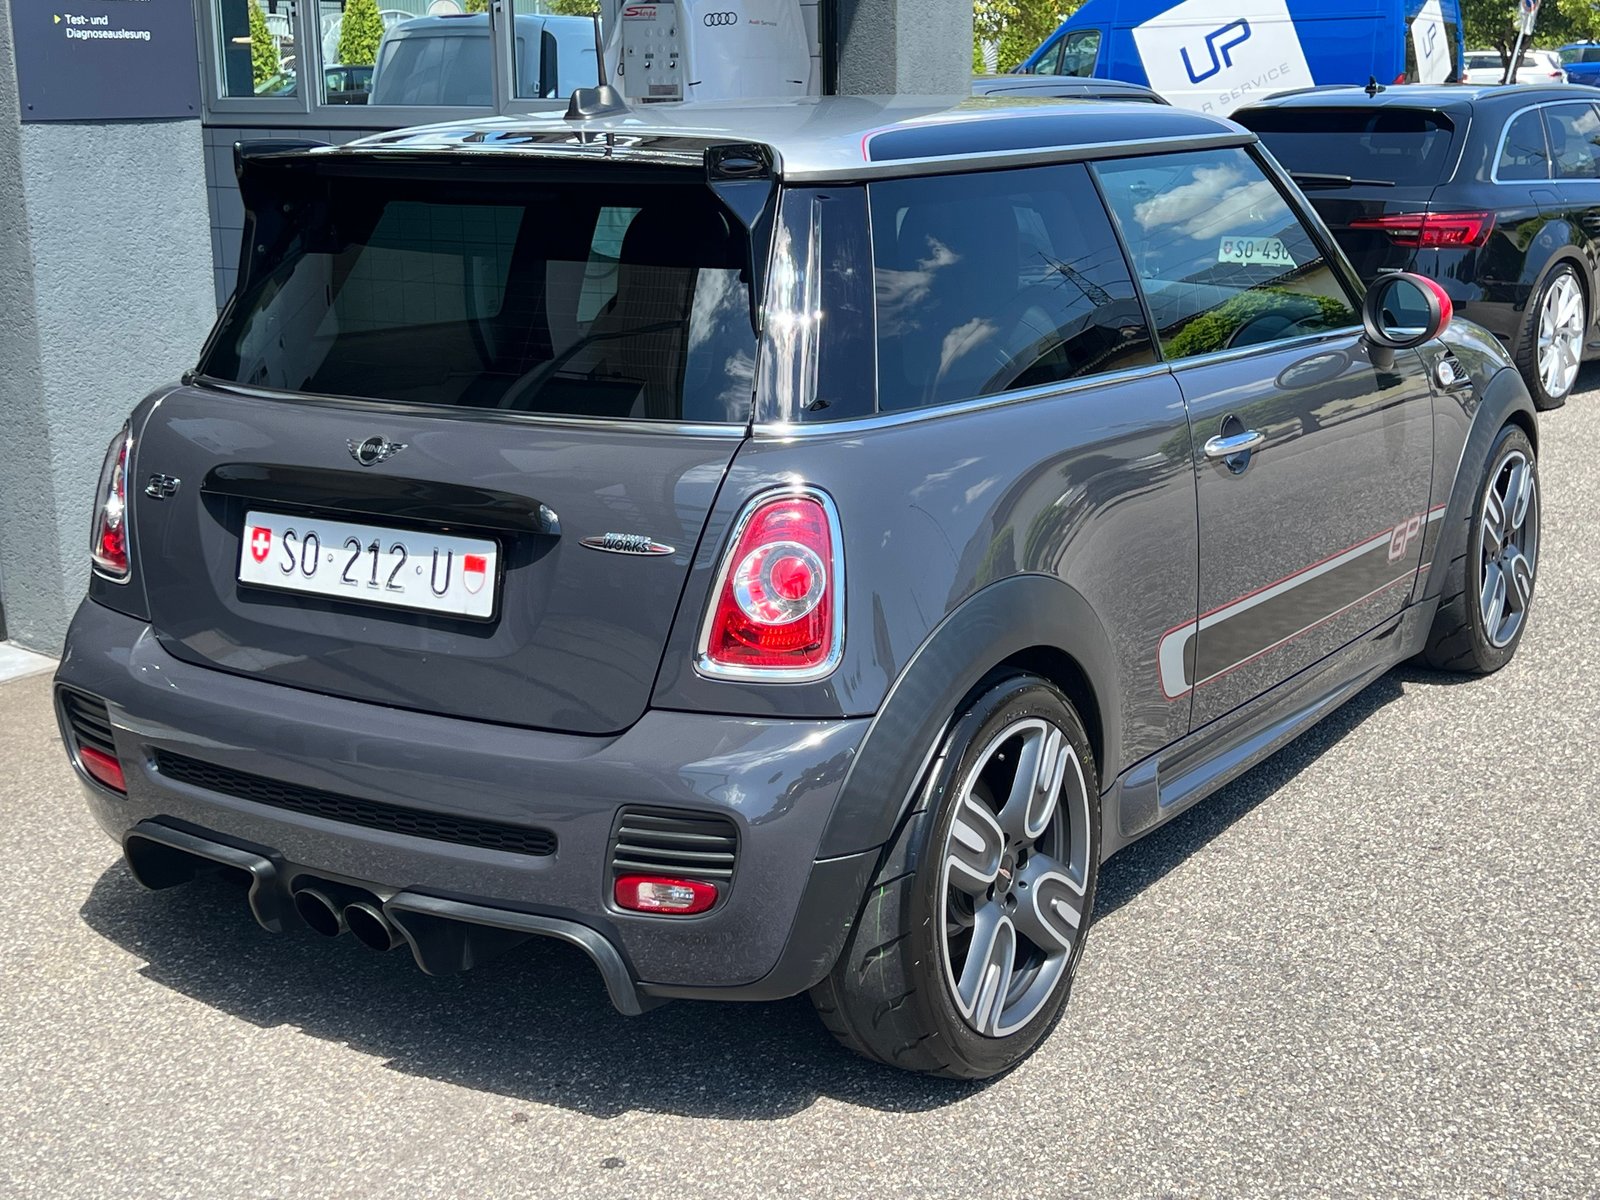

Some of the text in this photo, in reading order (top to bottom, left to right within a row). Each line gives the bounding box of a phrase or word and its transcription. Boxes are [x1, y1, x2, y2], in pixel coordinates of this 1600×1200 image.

[64, 14, 109, 26] Test- und
[66, 28, 151, 41] Diagnoseauslesung
[1180, 18, 1251, 84] UP
[1219, 62, 1291, 105] SERVICE
[362, 443, 383, 454] MINI
[145, 472, 181, 500] GP
[603, 538, 649, 553] WORKS
[1387, 514, 1421, 566] GP
